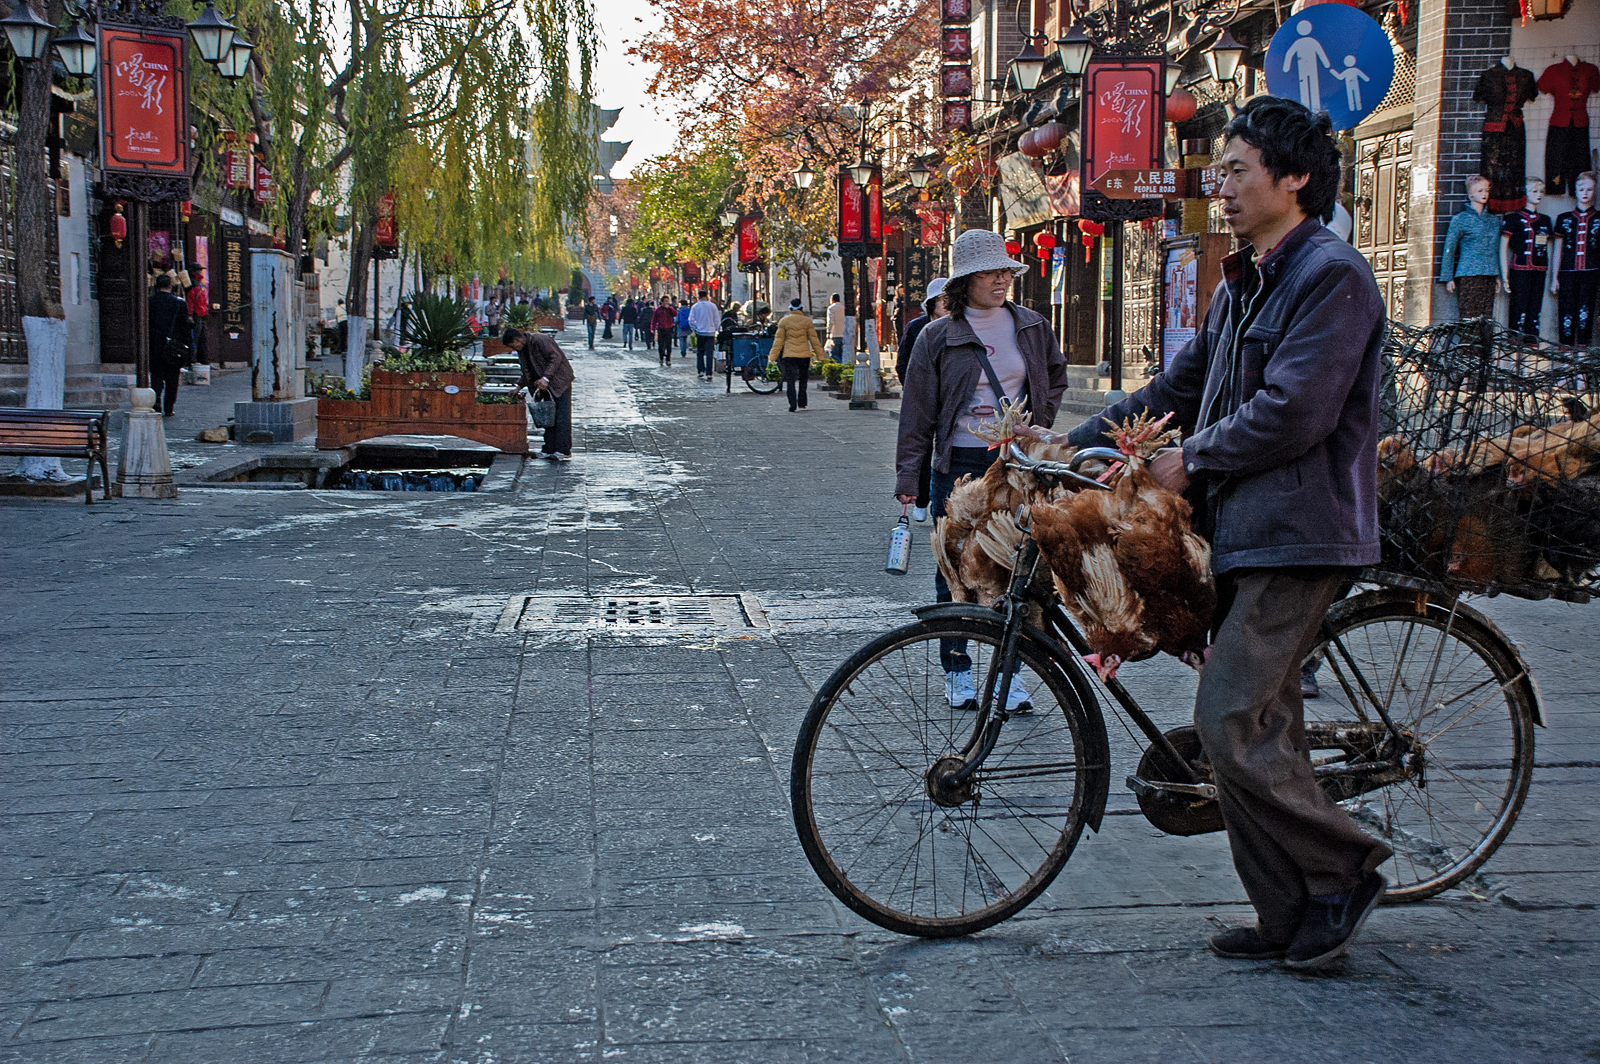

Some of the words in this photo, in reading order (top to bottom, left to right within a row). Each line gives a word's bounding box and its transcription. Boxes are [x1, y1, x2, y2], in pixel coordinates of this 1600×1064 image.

[142, 61, 169, 72] CHINA
[1133, 170, 1176, 185] 人民路
